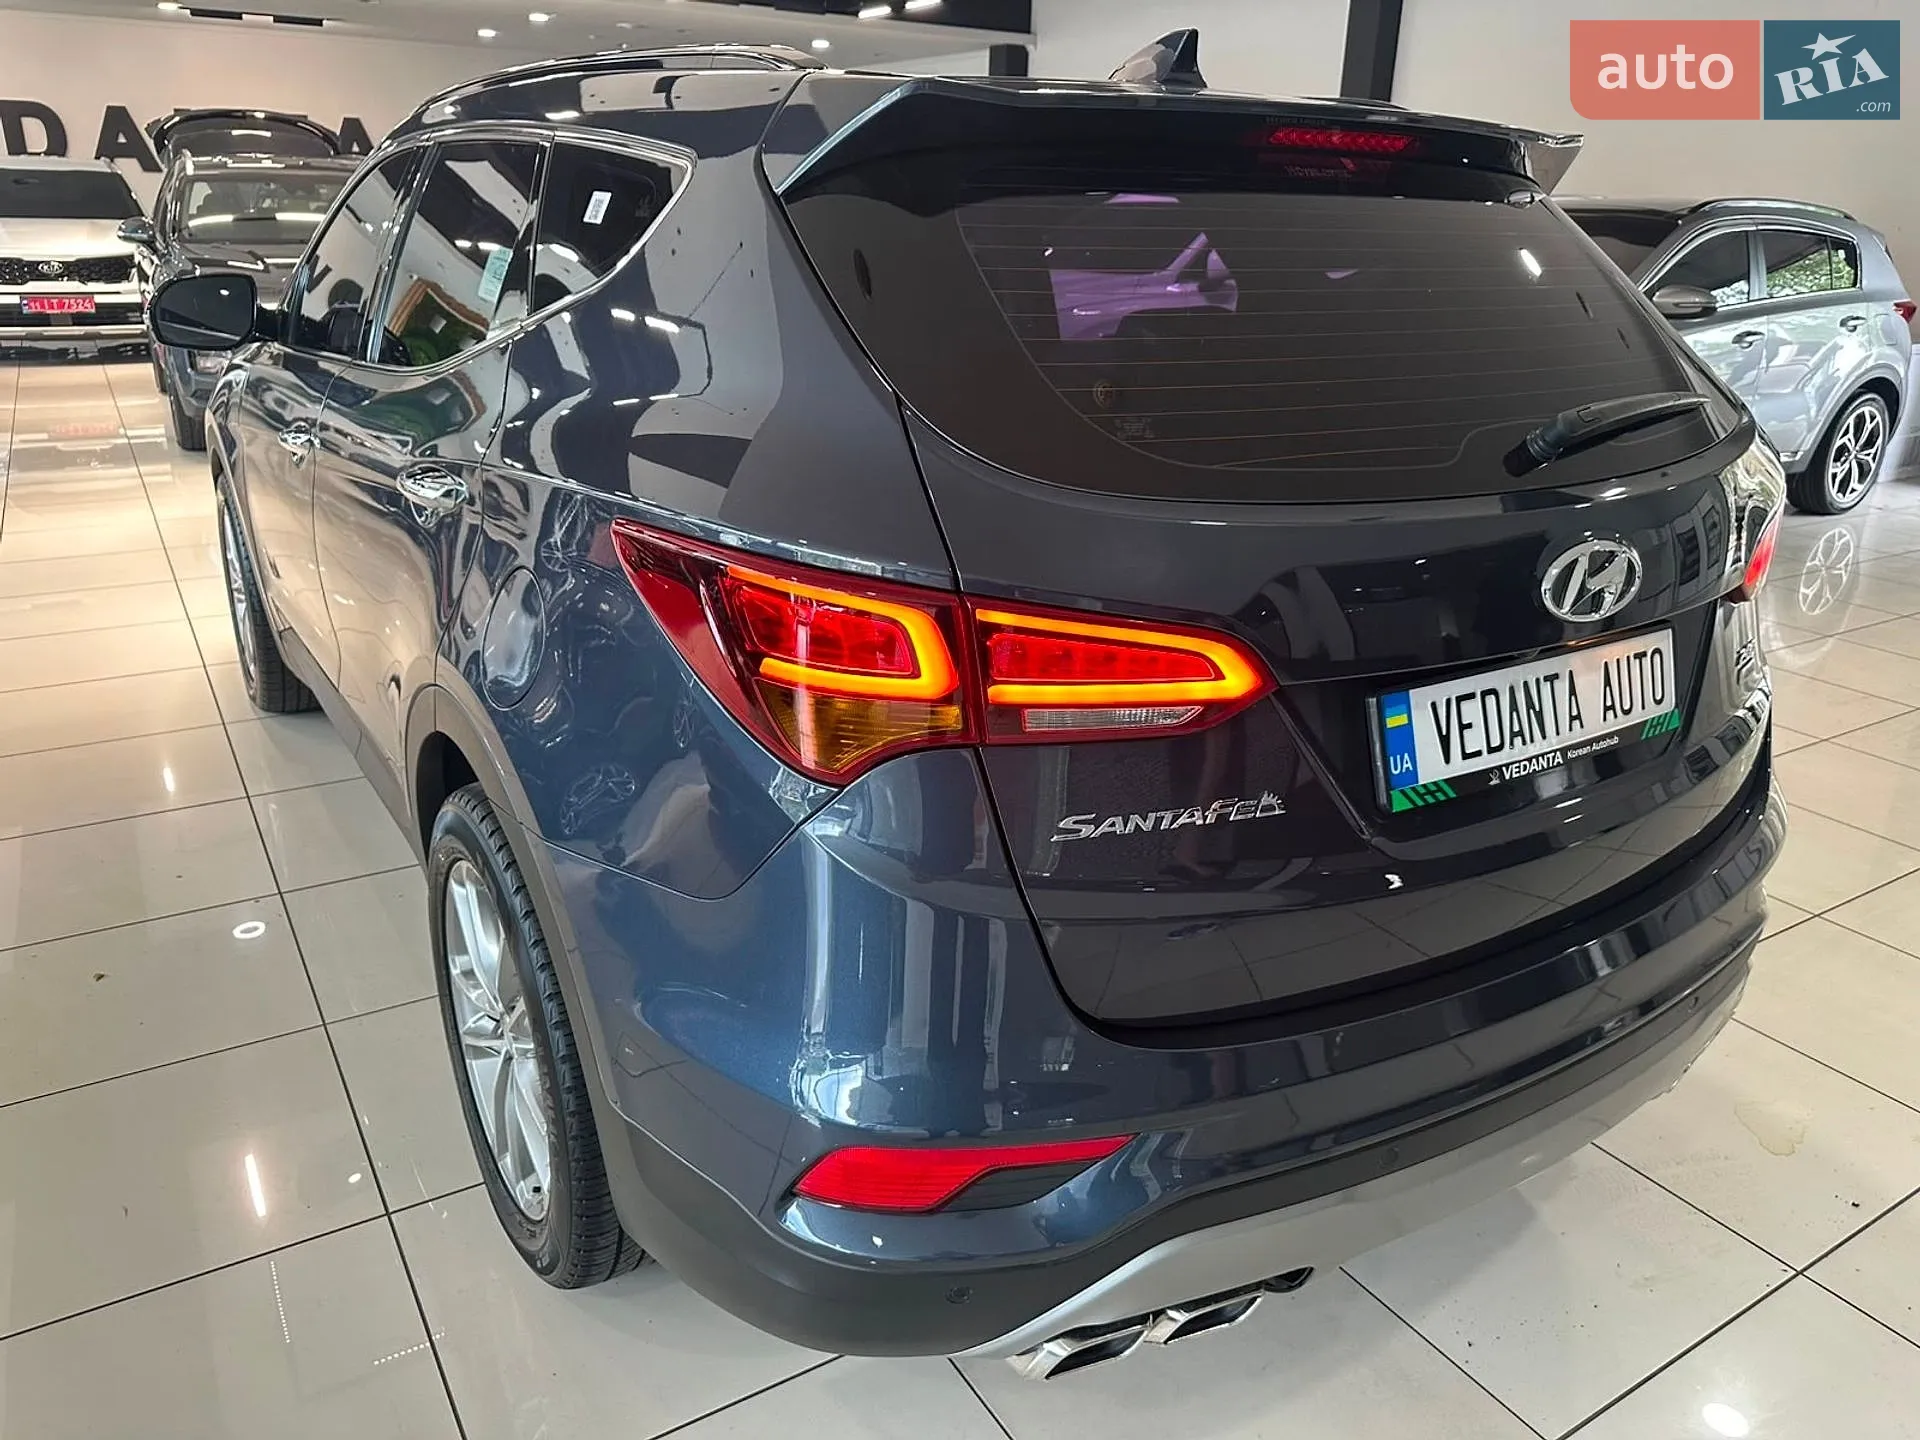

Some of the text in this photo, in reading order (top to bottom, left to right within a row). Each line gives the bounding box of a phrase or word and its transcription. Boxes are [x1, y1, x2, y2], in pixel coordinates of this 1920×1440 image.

[1430, 669, 1585, 765] VEDANTA
[1602, 647, 1665, 723] AUTO
[1389, 753, 1413, 775] UA
[1502, 736, 1619, 780] VEDANTA Korean Autohub
